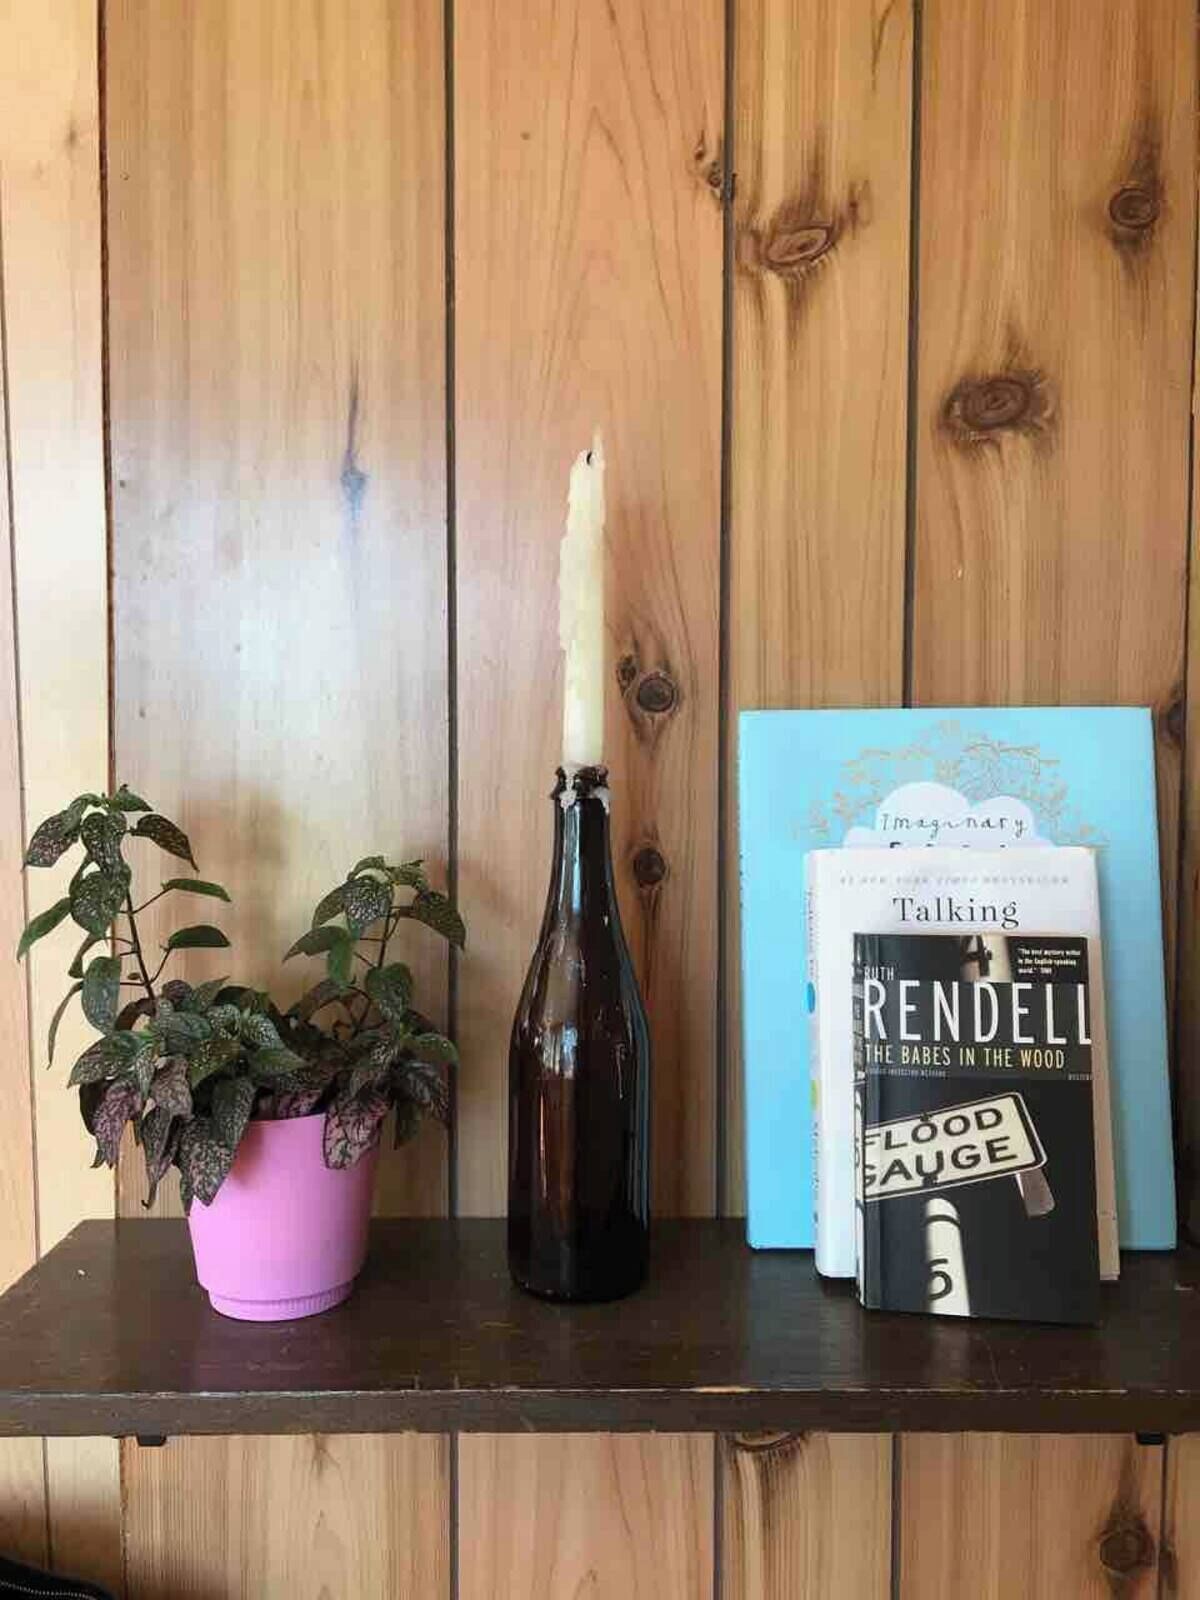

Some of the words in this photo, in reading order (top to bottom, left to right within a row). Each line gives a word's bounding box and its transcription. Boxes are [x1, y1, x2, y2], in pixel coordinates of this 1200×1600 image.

[892, 896, 1020, 930] Talking
[864, 966, 894, 981] RUTH
[864, 980, 1092, 1046] RENDELL
[864, 1044, 893, 1065] THE
[901, 1046, 951, 1066] BABES
[959, 1047, 975, 1067] IN
[984, 1048, 1013, 1068] THE
[1019, 1049, 1066, 1070] WOOD
[864, 1107, 1003, 1151] FLOOD
[864, 1135, 1018, 1189] GAUGE
